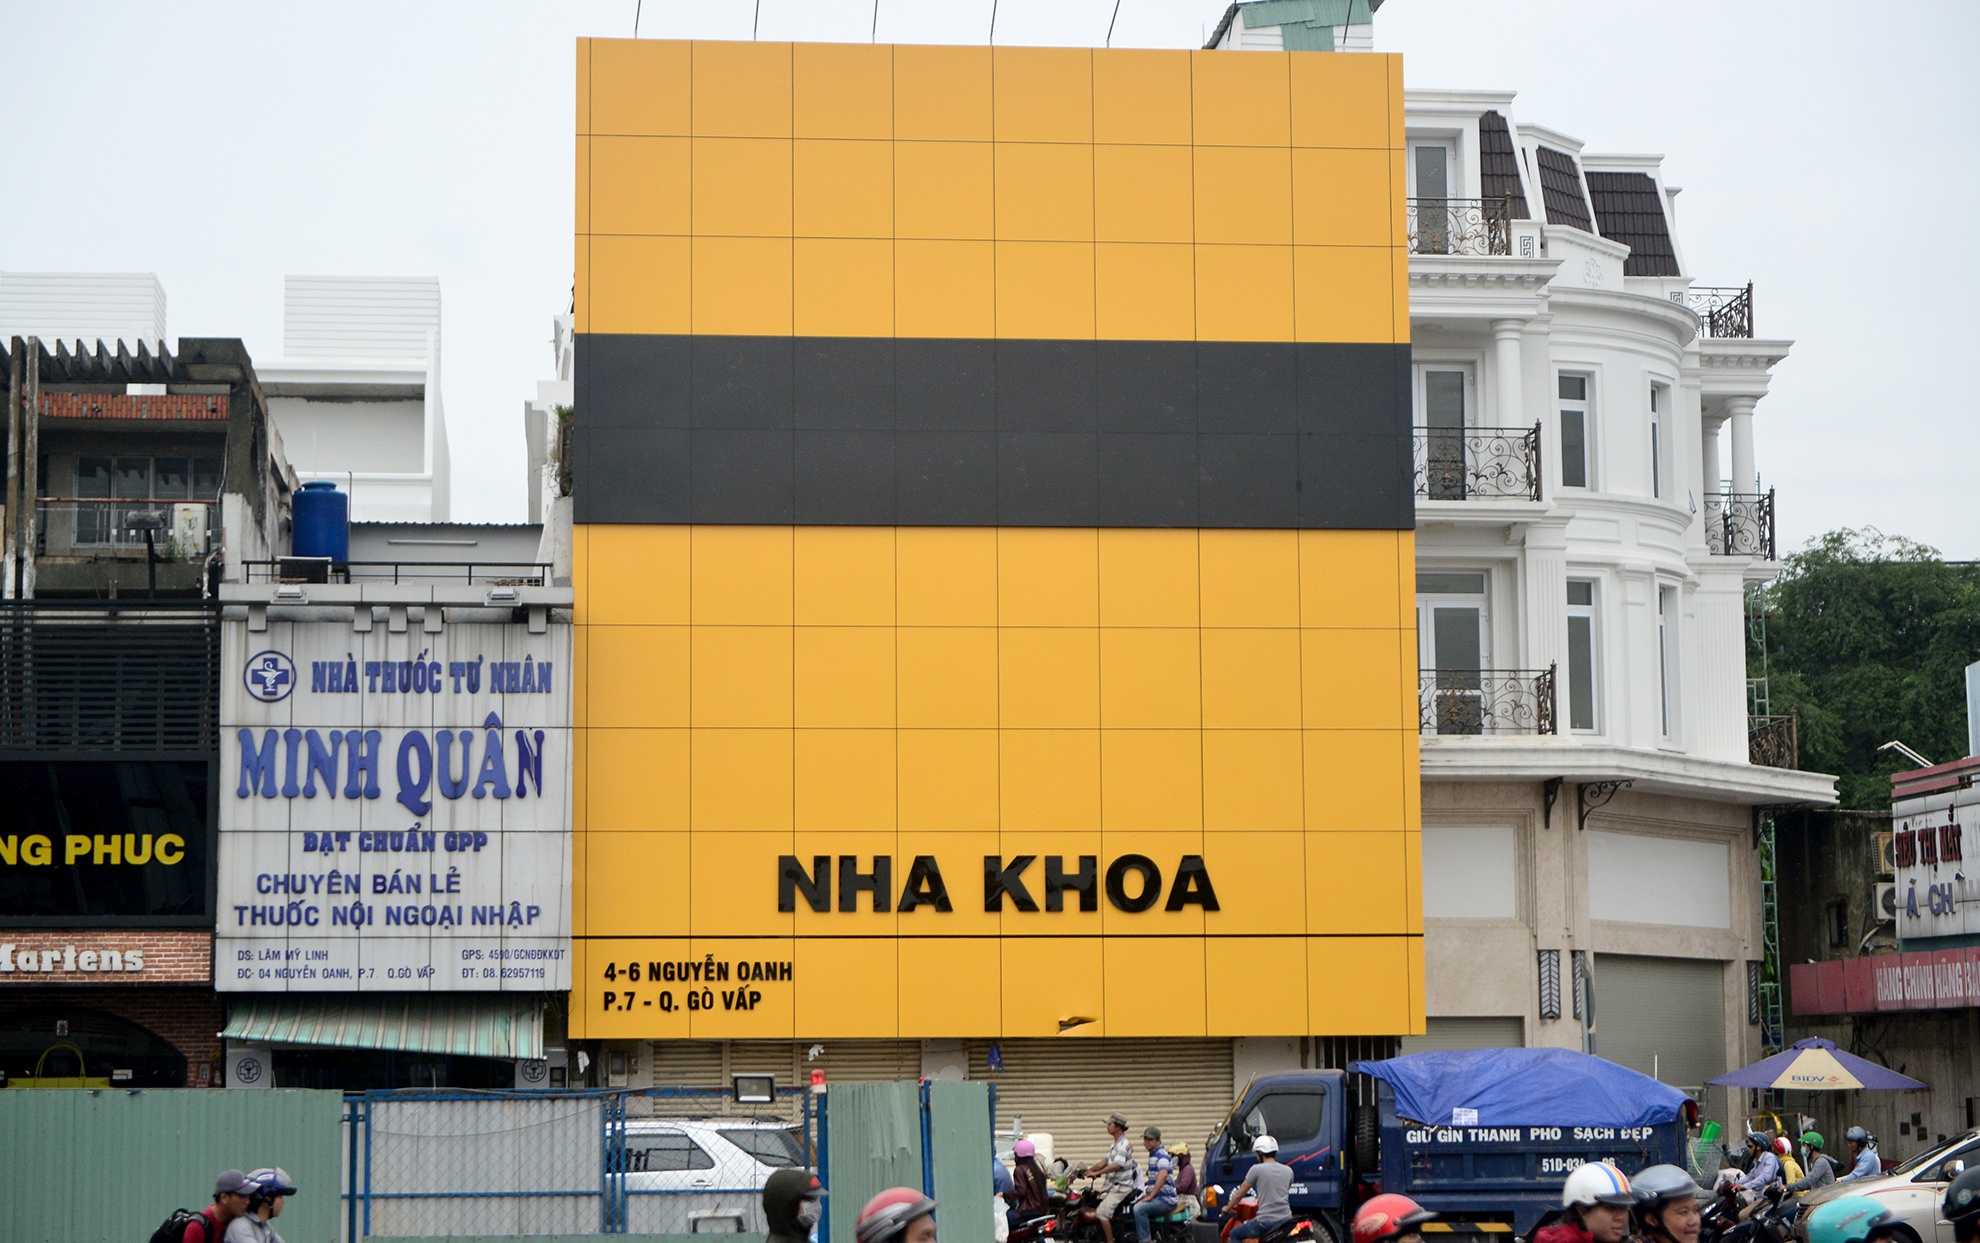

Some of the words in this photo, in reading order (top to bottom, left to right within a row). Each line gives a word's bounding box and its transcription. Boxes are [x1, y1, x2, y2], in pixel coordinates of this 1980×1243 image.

[311, 652, 359, 693] NHÀ
[365, 648, 442, 694] THUỐC
[450, 654, 484, 694] TƯ
[490, 654, 553, 693] NHÂN
[236, 728, 382, 799] MINH
[396, 711, 545, 817] QUÂN
[0, 834, 52, 866] NG
[65, 833, 185, 866] PHUC
[303, 831, 351, 856] ĐẠT
[358, 822, 436, 852] CHUẨN
[443, 831, 488, 852] GPP
[256, 869, 361, 894] CHUYÊN
[372, 868, 422, 894] BÁN
[431, 866, 461, 893] LẺ
[777, 854, 953, 914] NHA
[983, 854, 1221, 914] KHOA
[234, 899, 320, 926] THUỐC
[332, 901, 374, 930] NỘI
[386, 904, 463, 930] NGOẠI
[471, 900, 541, 930] NHẬP
[258, 948, 281, 961] LÂM
[305, 951, 329, 961] LINH
[462, 950, 485, 960] GPS:
[604, 962, 641, 982] 4-6
[648, 953, 729, 982] NGUYỄN
[737, 961, 793, 982] OANH
[258, 968, 271, 979] 04
[275, 964, 317, 979] NGUYỄN
[322, 968, 353, 980] OANH,
[462, 968, 479, 979] ĐT:
[603, 991, 636, 1011] P.7
[659, 990, 680, 1012] Q.
[687, 986, 715, 1011] GÒ
[721, 984, 762, 1011] VẤP
[1791, 1074, 1826, 1082] BIDV
[1437, 1126, 1463, 1143] GÌN
[1573, 1127, 1615, 1142] SẠCH
